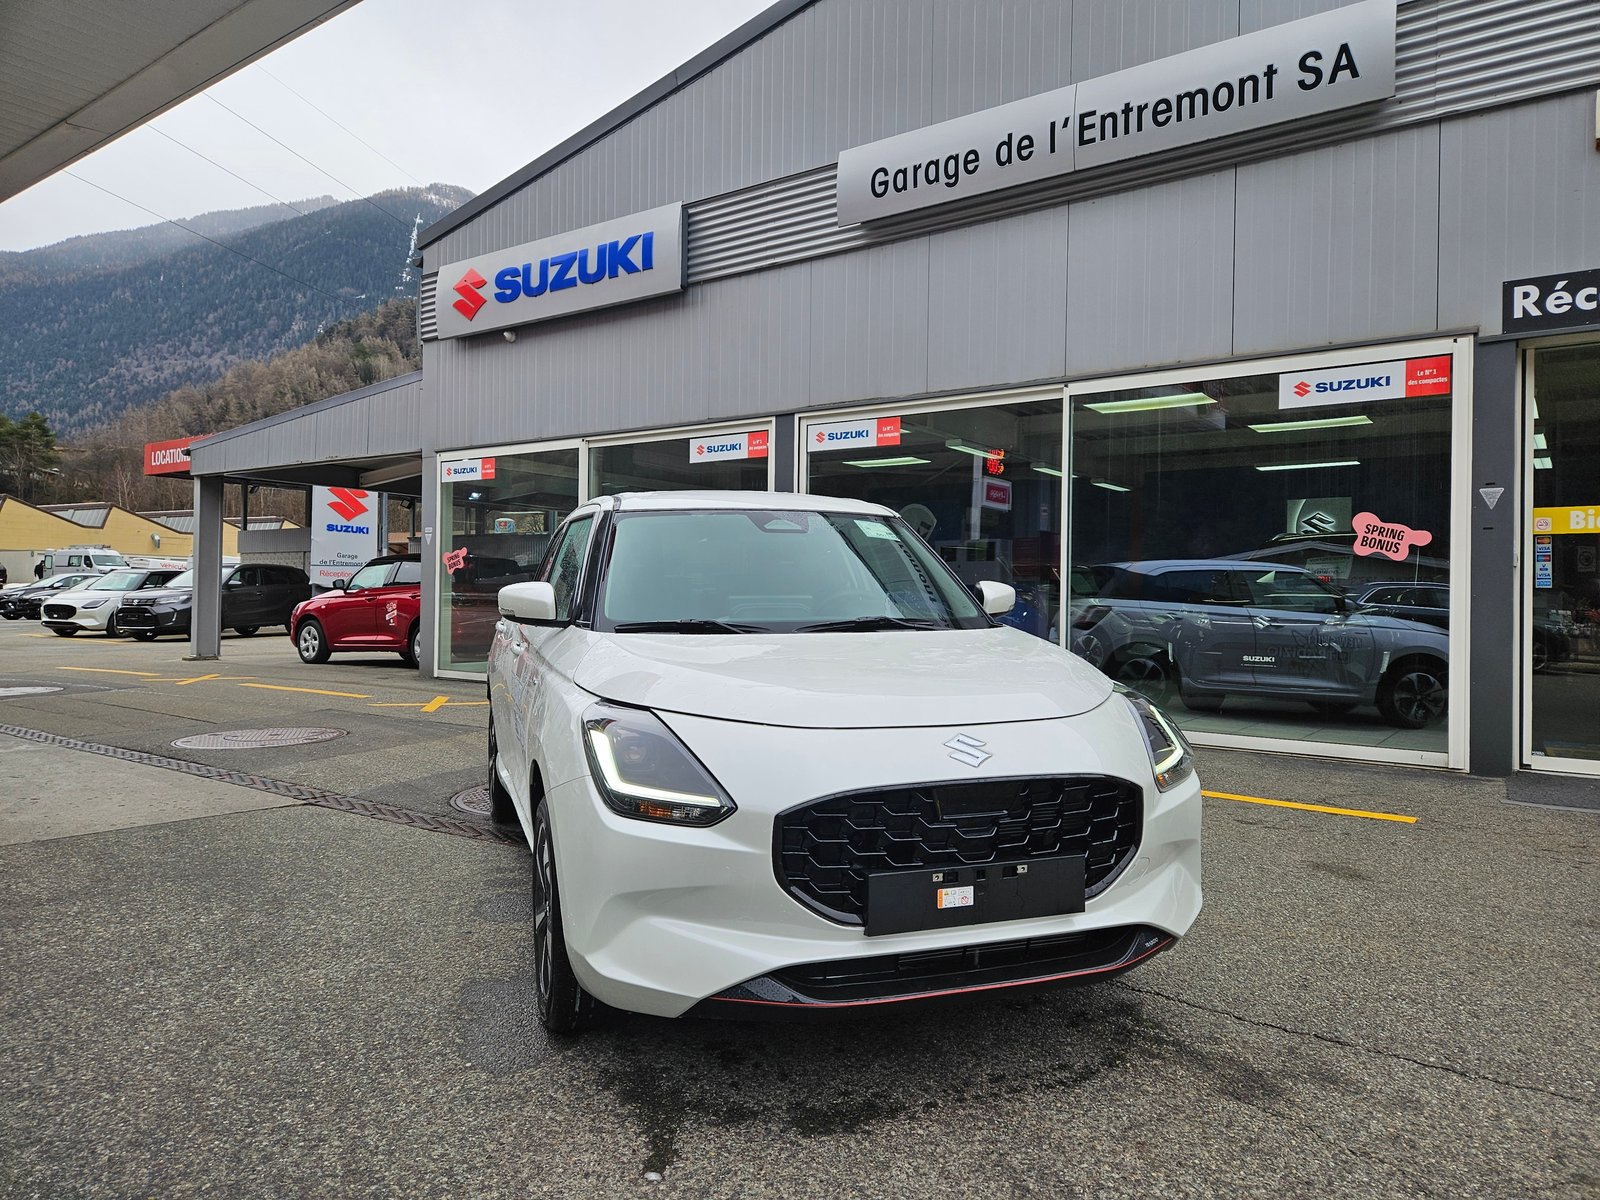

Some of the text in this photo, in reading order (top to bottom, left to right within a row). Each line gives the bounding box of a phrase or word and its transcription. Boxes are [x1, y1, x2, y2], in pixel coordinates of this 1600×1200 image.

[869, 42, 1361, 199] Garage de l'Entremont SA
[494, 231, 655, 304] SUZUKI
[1513, 280, 1600, 319] Réc
[1315, 375, 1391, 394] SUZUKI
[1418, 377, 1448, 386] compactes
[828, 429, 869, 441] SUZUKI
[707, 442, 742, 454] SUZUKI
[453, 467, 477, 475] SUZUKI
[1569, 509, 1600, 530] Bi
[326, 523, 370, 535] SUZUKI
[1364, 523, 1406, 541] SPRING
[1360, 535, 1401, 553] BONUS
[336, 552, 359, 560] Garage
[1242, 655, 1276, 663] SUZUKI
